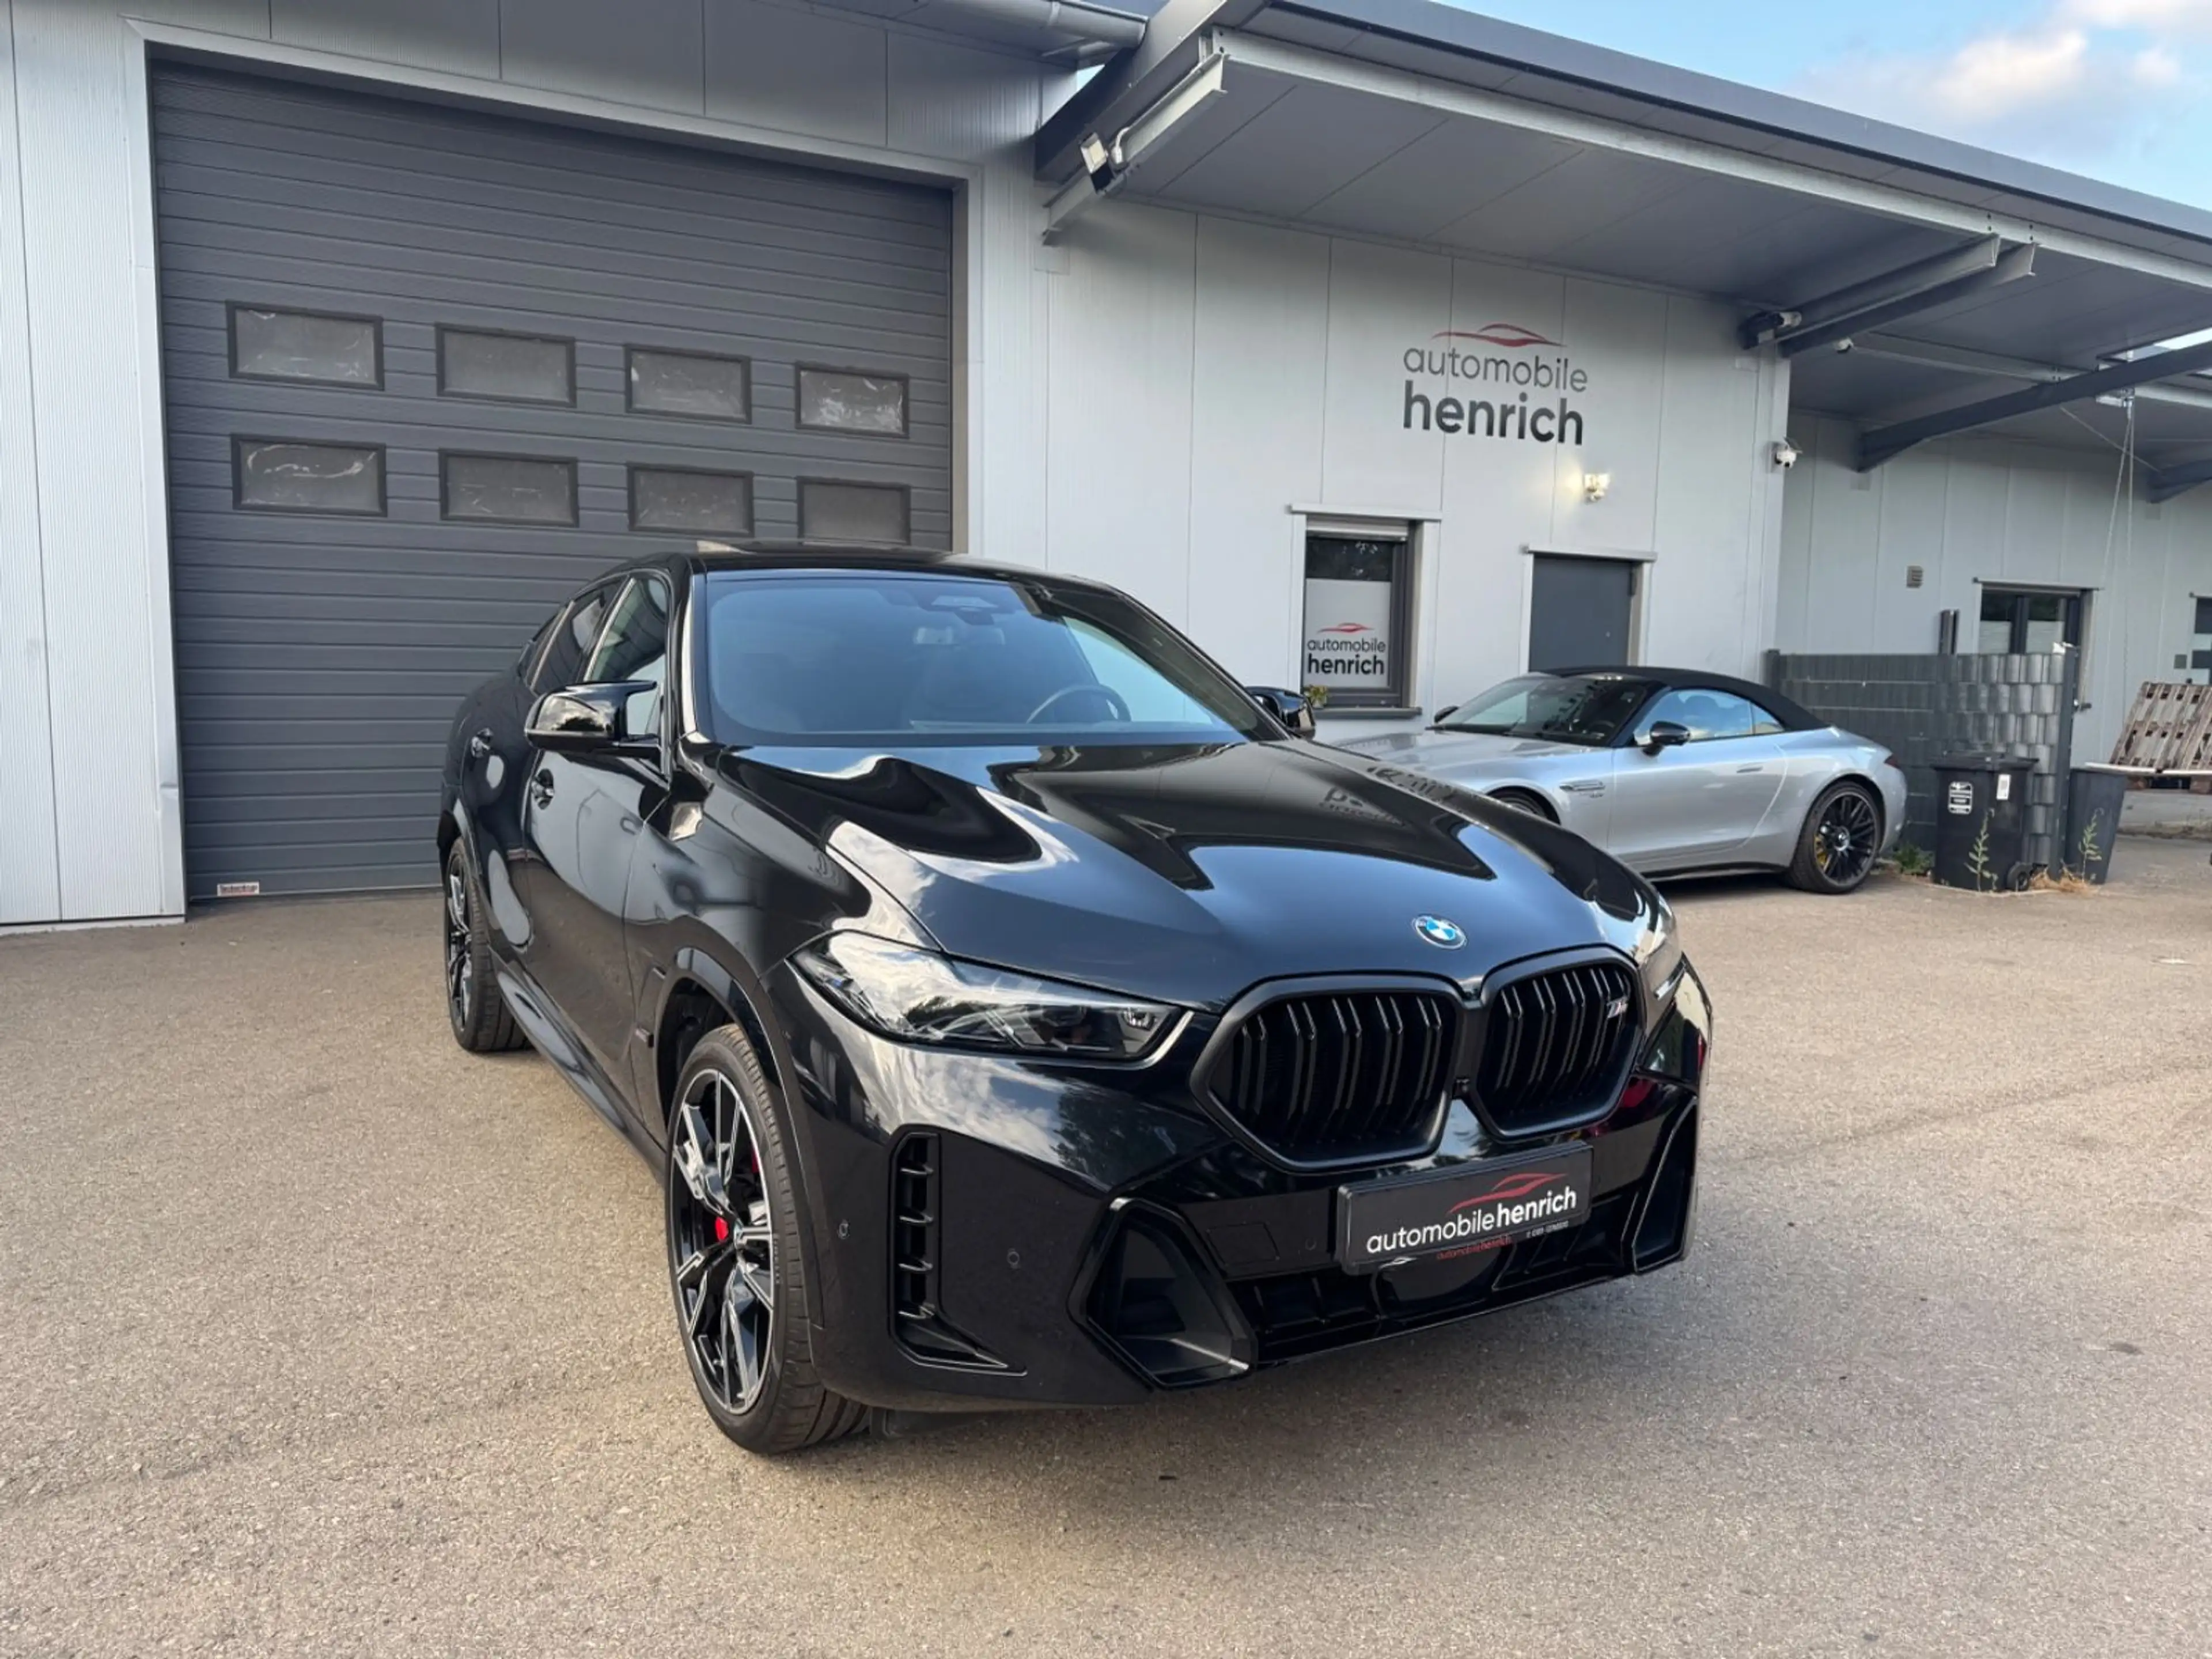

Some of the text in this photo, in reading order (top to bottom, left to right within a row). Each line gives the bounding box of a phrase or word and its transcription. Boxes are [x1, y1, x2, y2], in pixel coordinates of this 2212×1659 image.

[1403, 348, 1588, 392] automobile
[1403, 380, 1583, 445] henrich
[1307, 638, 1386, 652] automobile
[1308, 653, 1384, 675] henrich
